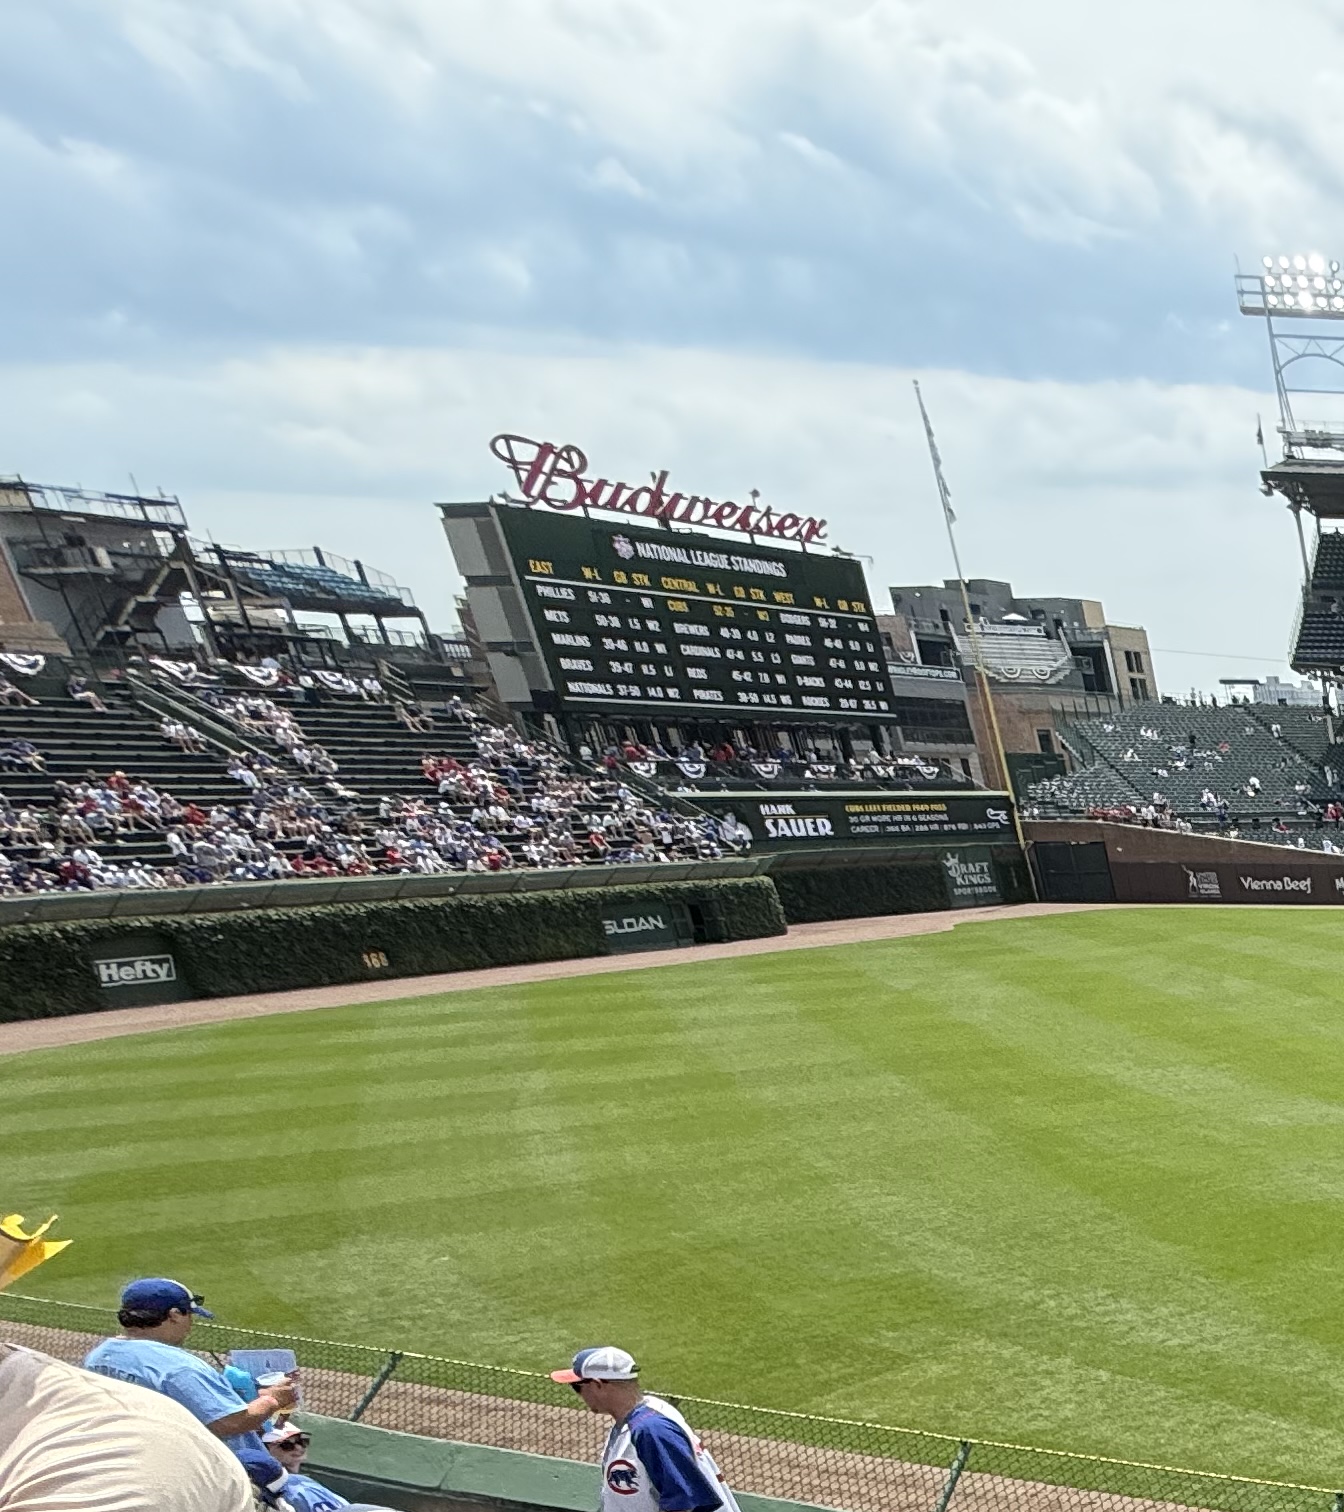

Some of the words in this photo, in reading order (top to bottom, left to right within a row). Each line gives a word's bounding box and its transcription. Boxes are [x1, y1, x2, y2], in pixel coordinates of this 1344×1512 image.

[489, 433, 829, 545] Budweiser
[529, 559, 554, 575] EAST
[636, 541, 692, 565] NATIONAL
[691, 549, 732, 571] LEAGUE
[730, 555, 788, 578] STANDINGS
[535, 584, 577, 601] PHILLIES
[661, 577, 700, 593] CENTRAL
[543, 608, 571, 624] METS
[566, 681, 615, 697] NATIONALS
[759, 803, 796, 816] HANK
[764, 818, 835, 838] SAUER
[949, 861, 990, 879] DRAFT
[955, 873, 993, 887] KINGS
[1239, 876, 1284, 892] Vienna
[1283, 876, 1313, 895] Beef
[602, 915, 667, 936] SLOAN
[101, 959, 170, 982] Hefty
